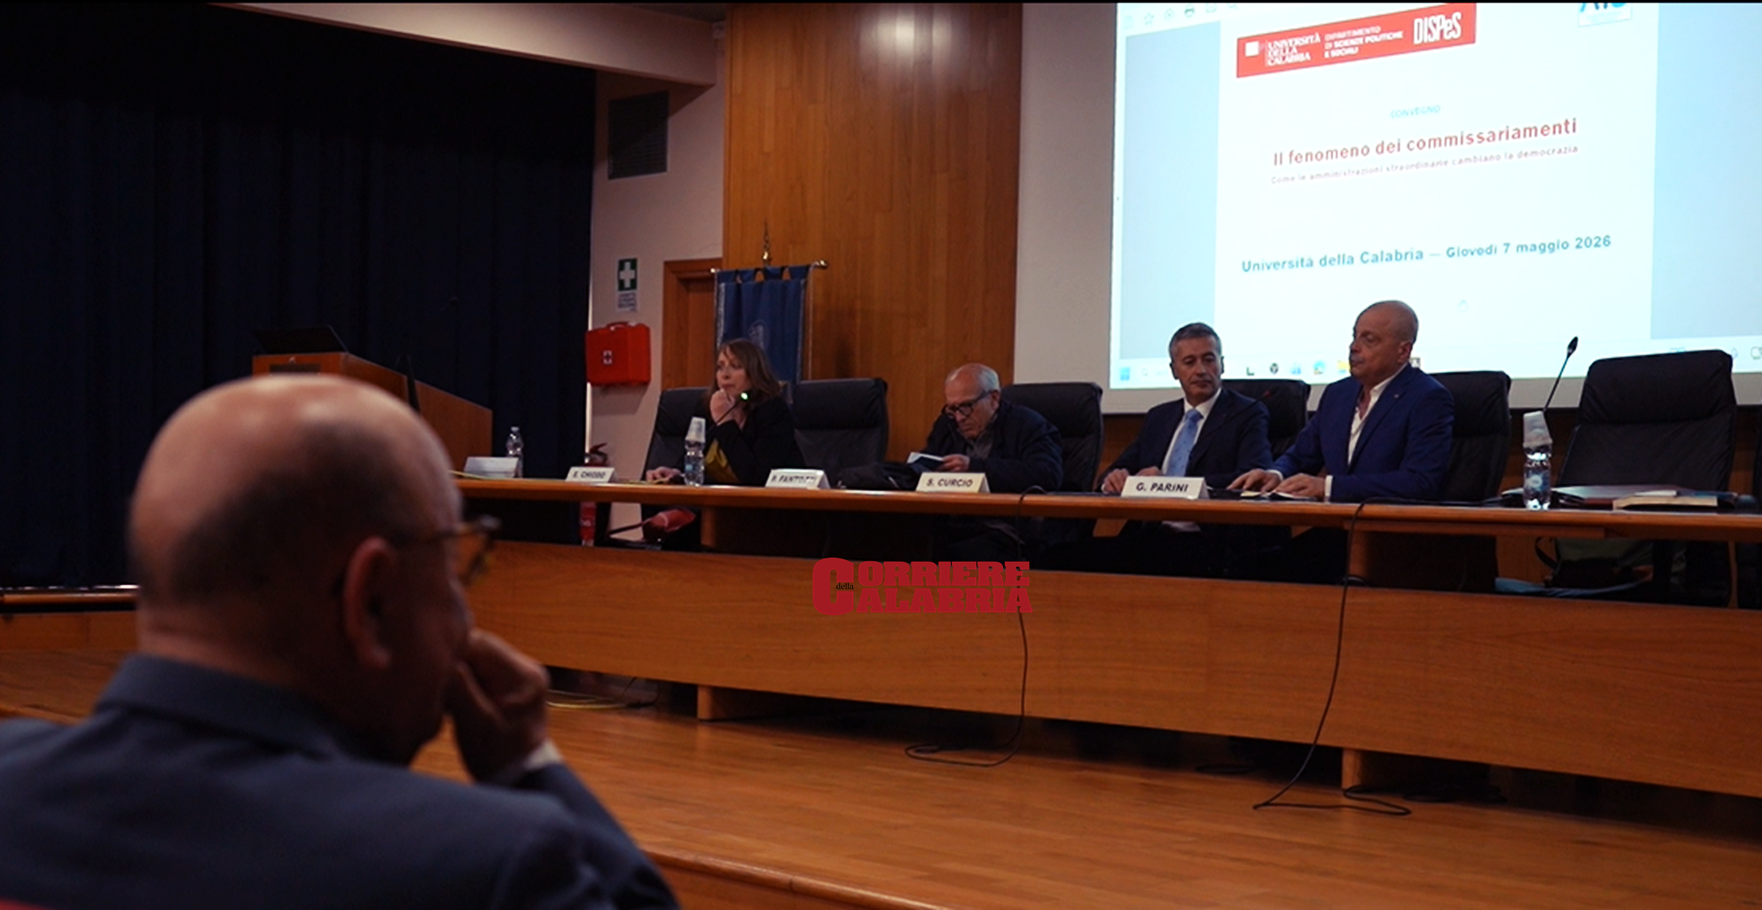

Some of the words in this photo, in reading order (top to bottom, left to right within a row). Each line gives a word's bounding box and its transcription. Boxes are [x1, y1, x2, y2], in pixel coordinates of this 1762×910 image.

[1413, 12, 1462, 45] DISPeS
[1390, 105, 1441, 118] CONVEGNO
[1274, 152, 1283, 166] Il
[1289, 145, 1370, 165] fenomeno
[1375, 138, 1401, 155] dei
[1407, 117, 1577, 151] commissariamenti
[1271, 176, 1295, 184] Come
[1299, 173, 1306, 181] le
[1452, 153, 1501, 166] cambiano
[1504, 152, 1514, 160] la
[1517, 145, 1579, 159] democrazia
[1242, 256, 1314, 272] Università
[1319, 253, 1354, 267] della
[1360, 247, 1424, 264] Calabria
[1503, 242, 1511, 254] 7
[1516, 239, 1570, 254] maggio
[1575, 235, 1611, 249] 2026
[926, 478, 935, 487] S.
[937, 478, 973, 488] CURCIO
[1136, 482, 1147, 492] G.
[1150, 482, 1189, 493] PARINI
